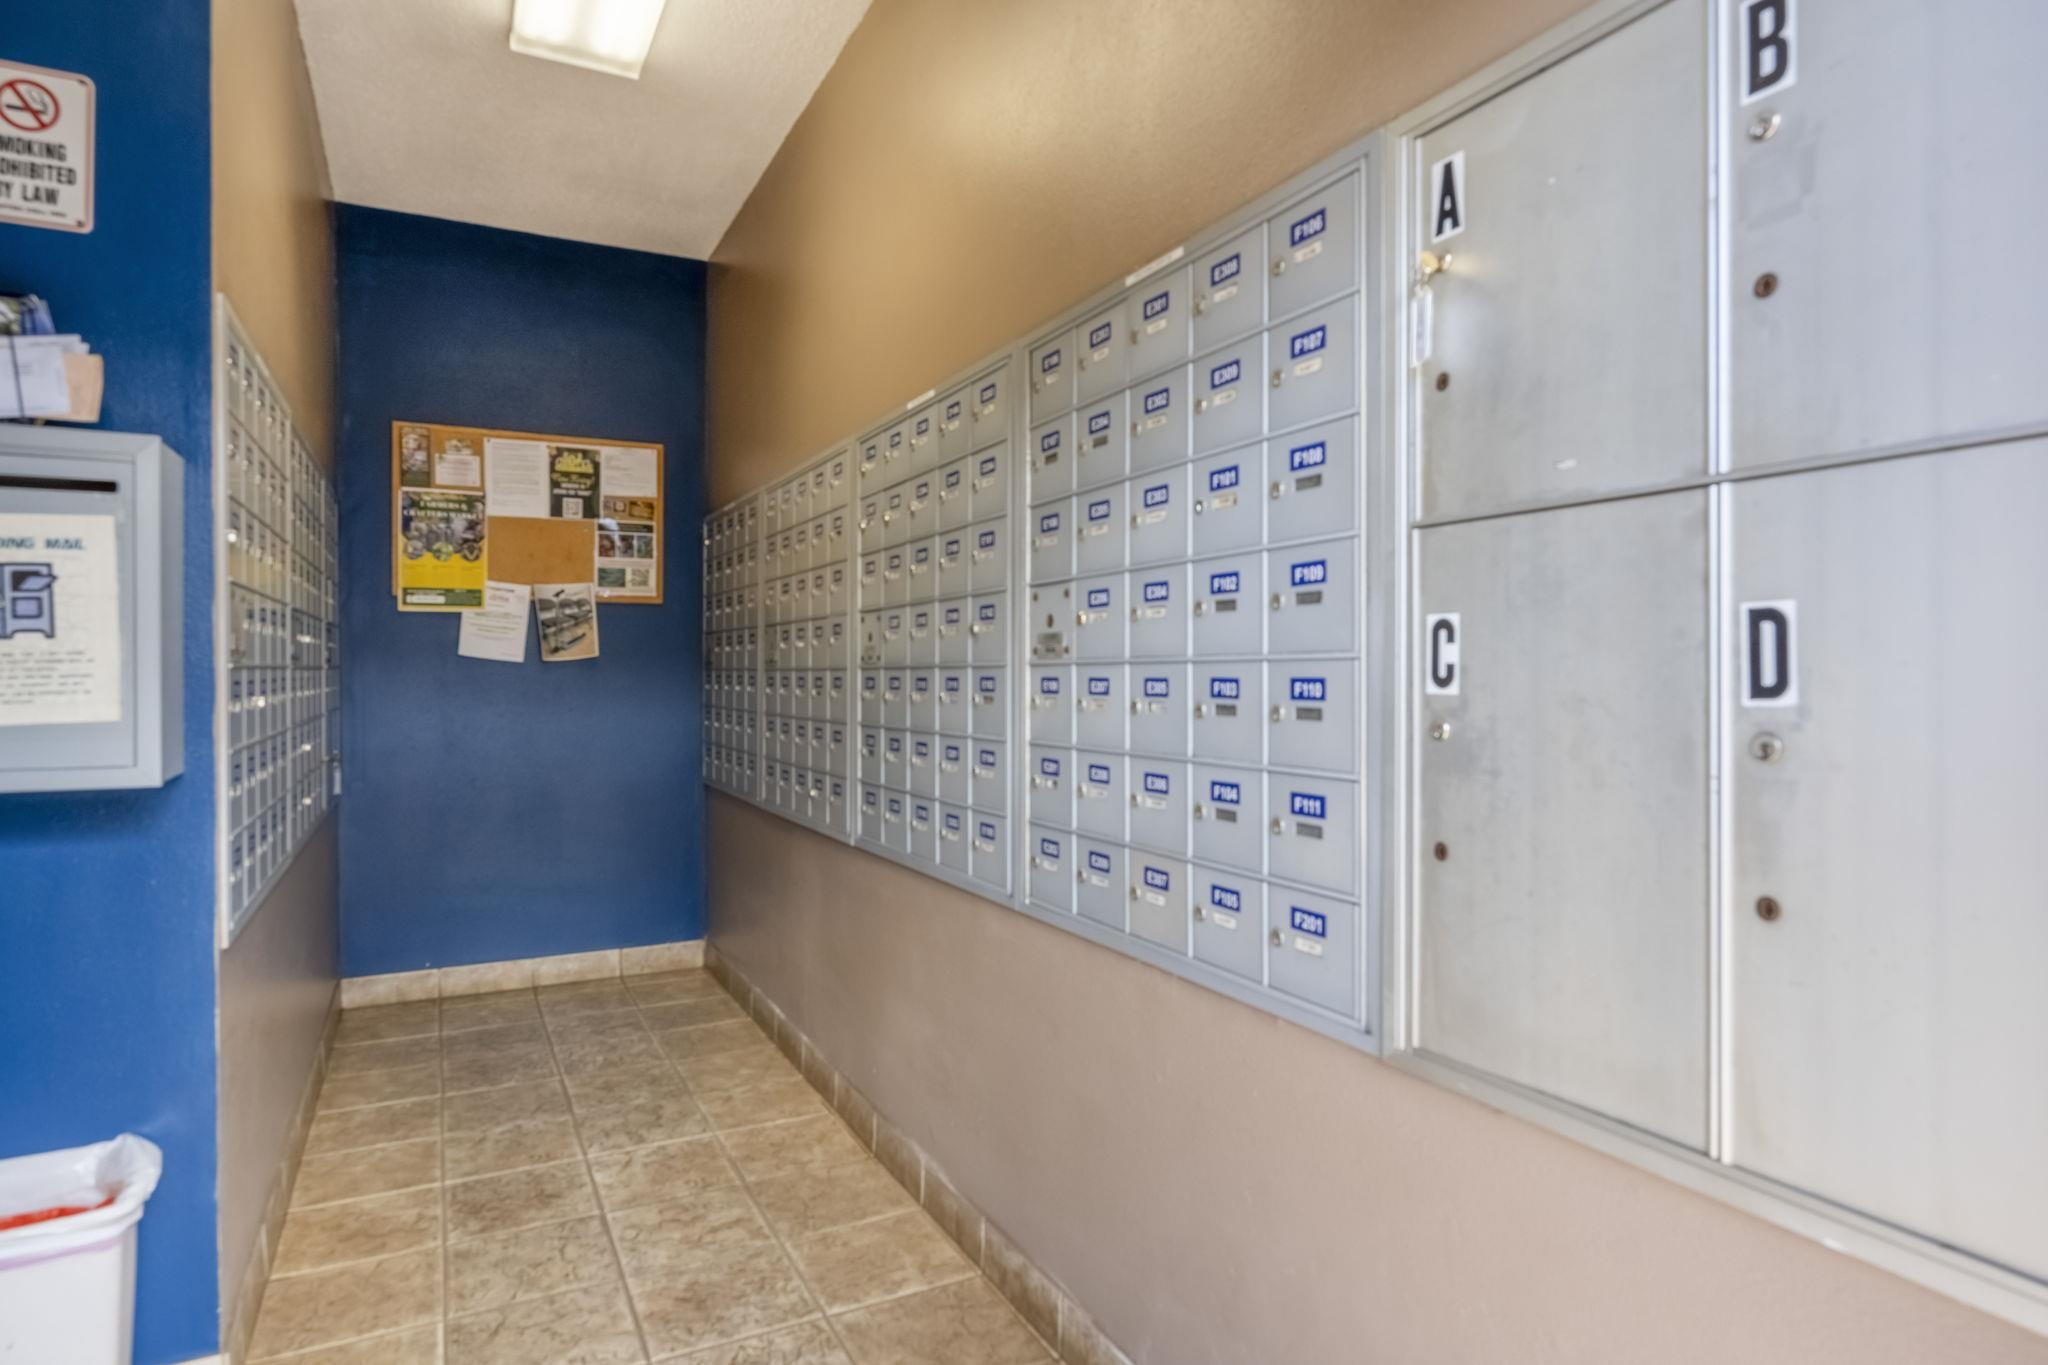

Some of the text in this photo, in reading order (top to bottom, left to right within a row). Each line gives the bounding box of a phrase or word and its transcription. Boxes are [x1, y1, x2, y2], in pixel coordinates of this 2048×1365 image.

[1747, 0, 1789, 96] B
[22, 183, 60, 206] LAW
[1435, 160, 1460, 237] A
[1431, 618, 1455, 688] C
[1748, 607, 1789, 699] D
[1293, 796, 1322, 816] F111
